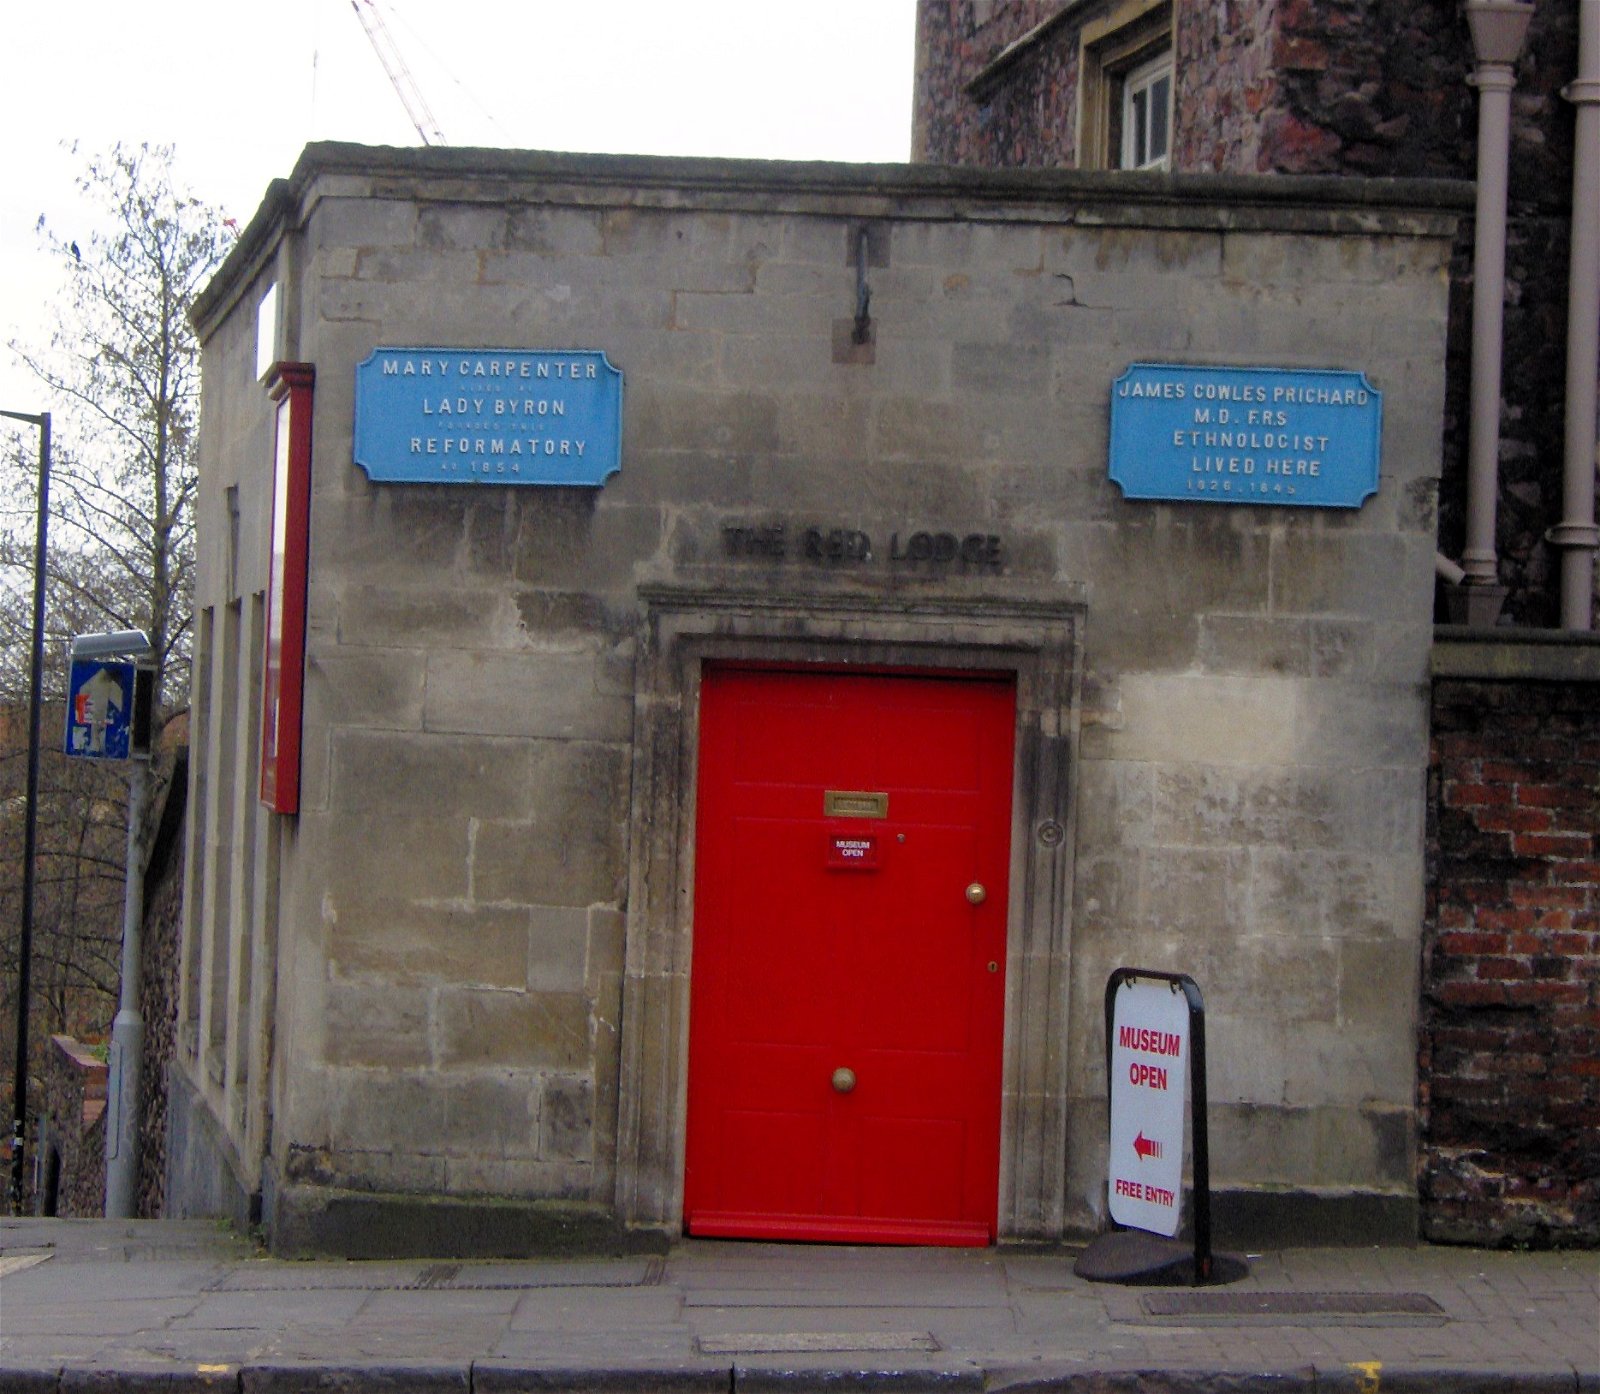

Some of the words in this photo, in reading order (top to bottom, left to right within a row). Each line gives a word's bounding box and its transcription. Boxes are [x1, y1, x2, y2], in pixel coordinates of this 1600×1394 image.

[383, 359, 449, 376] MARY
[458, 360, 597, 379] CARPENTER
[1119, 382, 1186, 399] JAMES
[1193, 384, 1266, 402] COWLES
[1273, 386, 1368, 406] PRICHARD
[423, 398, 485, 415] LADY
[494, 398, 565, 416] BYRON
[410, 438, 586, 456] REFORMATORY
[471, 462, 520, 474] 1854
[1193, 456, 1255, 474] LIVED
[1266, 459, 1321, 477] HERE
[722, 525, 785, 558] THE
[805, 526, 871, 560] RED
[891, 531, 1001, 566] LODGE
[835, 840, 870, 849] MUSEUM
[841, 849, 864, 857] OPEN
[1119, 1025, 1180, 1057] MUSEUM
[1129, 1062, 1167, 1091] OPEN
[1115, 1178, 1142, 1201] FREE
[1145, 1185, 1175, 1208] ENTRY
